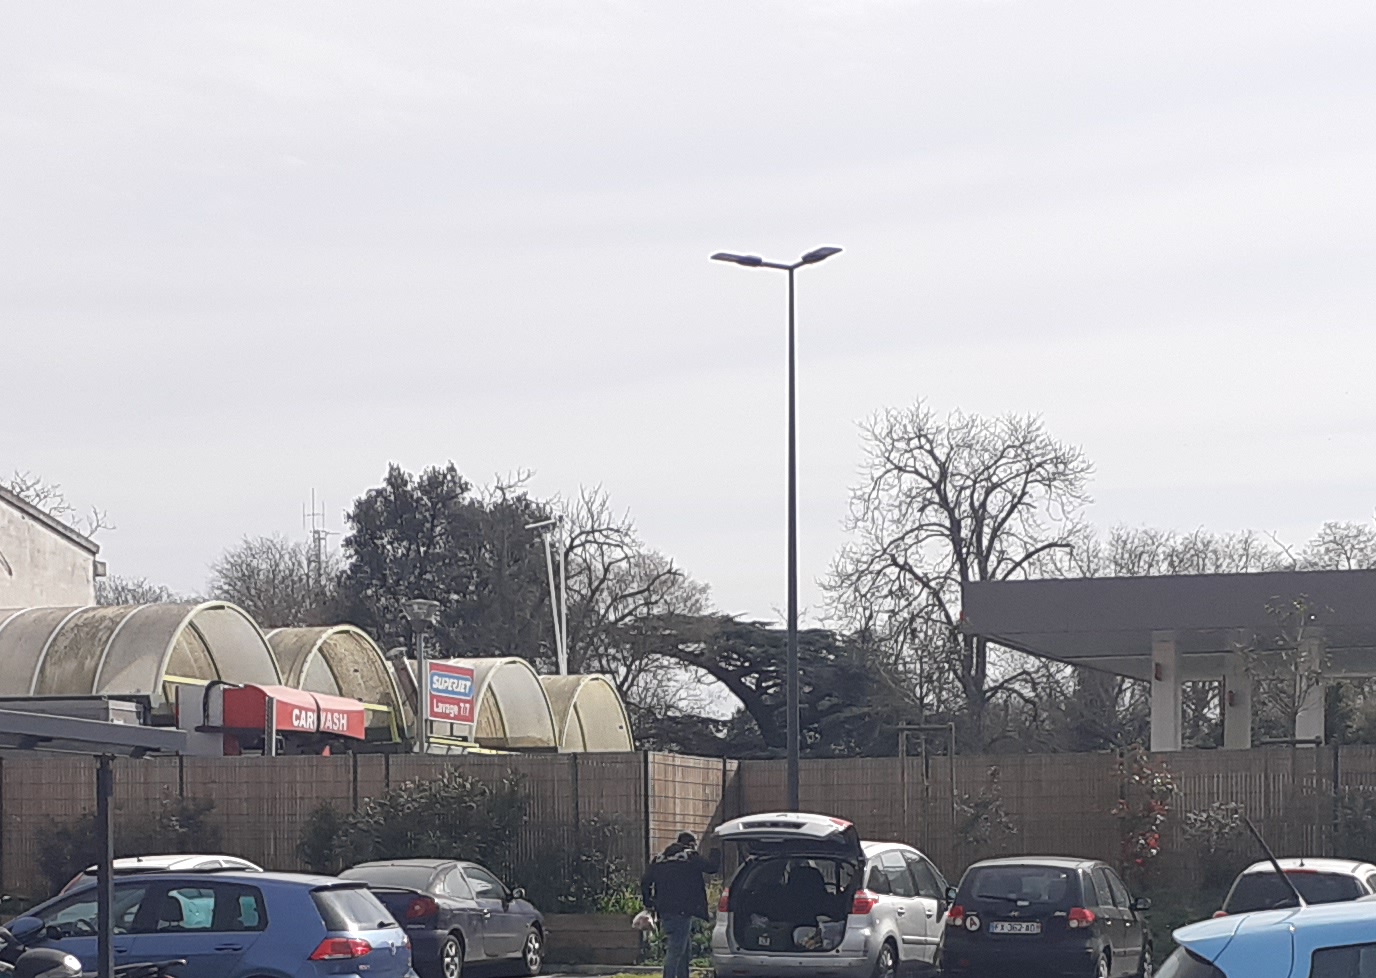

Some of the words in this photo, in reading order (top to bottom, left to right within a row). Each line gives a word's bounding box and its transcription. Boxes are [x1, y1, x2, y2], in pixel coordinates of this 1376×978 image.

[432, 675, 472, 694] SUPERJET
[433, 698, 459, 718] Lavage
[292, 708, 314, 730] CAR
